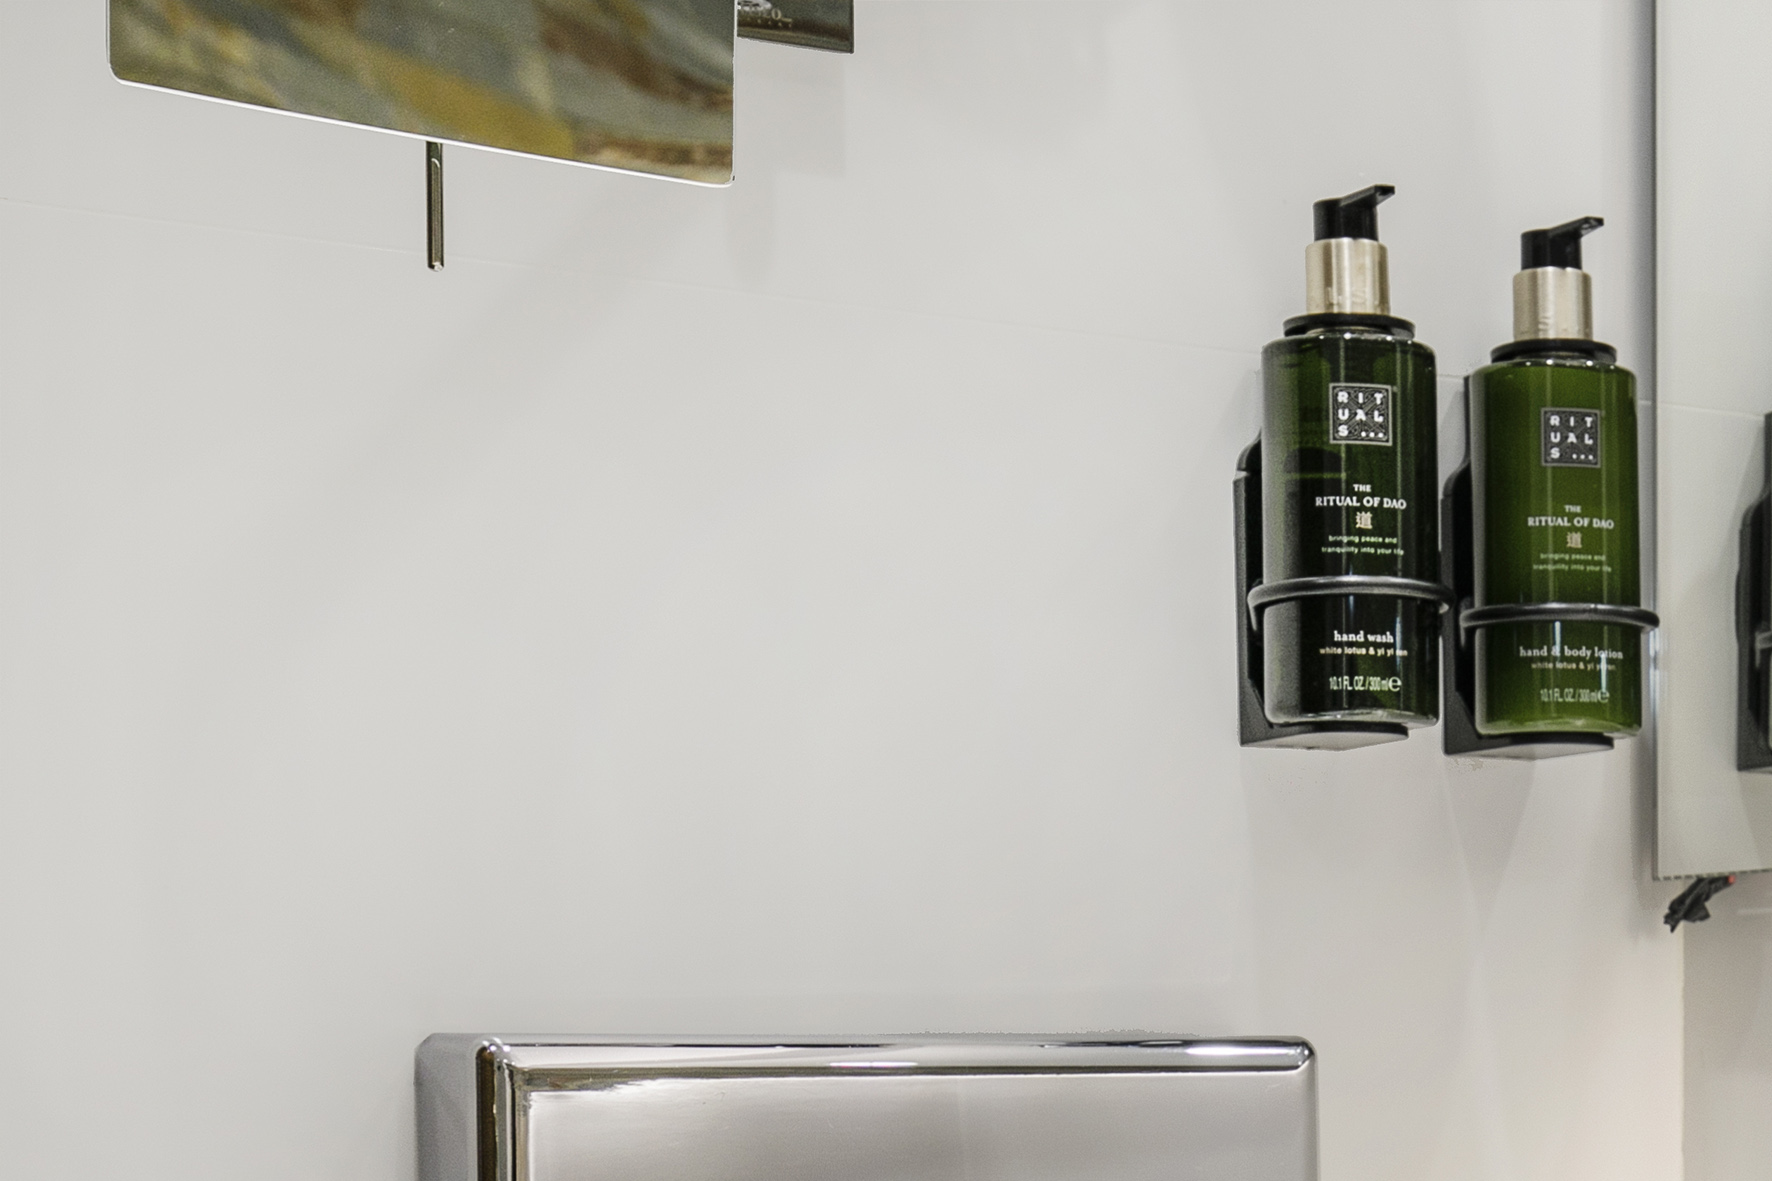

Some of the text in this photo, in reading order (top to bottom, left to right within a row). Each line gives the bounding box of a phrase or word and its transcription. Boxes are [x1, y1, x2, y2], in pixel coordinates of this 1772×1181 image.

[1353, 484, 1371, 492] THE
[1315, 496, 1407, 509] RITUAL OF DAO
[1564, 504, 1581, 513] THE
[1527, 516, 1614, 529] RITUAL OF DAO
[1334, 630, 1394, 643] hand wash
[1319, 646, 1342, 655] white
[1344, 646, 1366, 655] lotus
[1368, 646, 1375, 655] &
[1519, 645, 1623, 660] hand & body lotion
[1531, 661, 1554, 669] white
[1556, 661, 1577, 669] lotus
